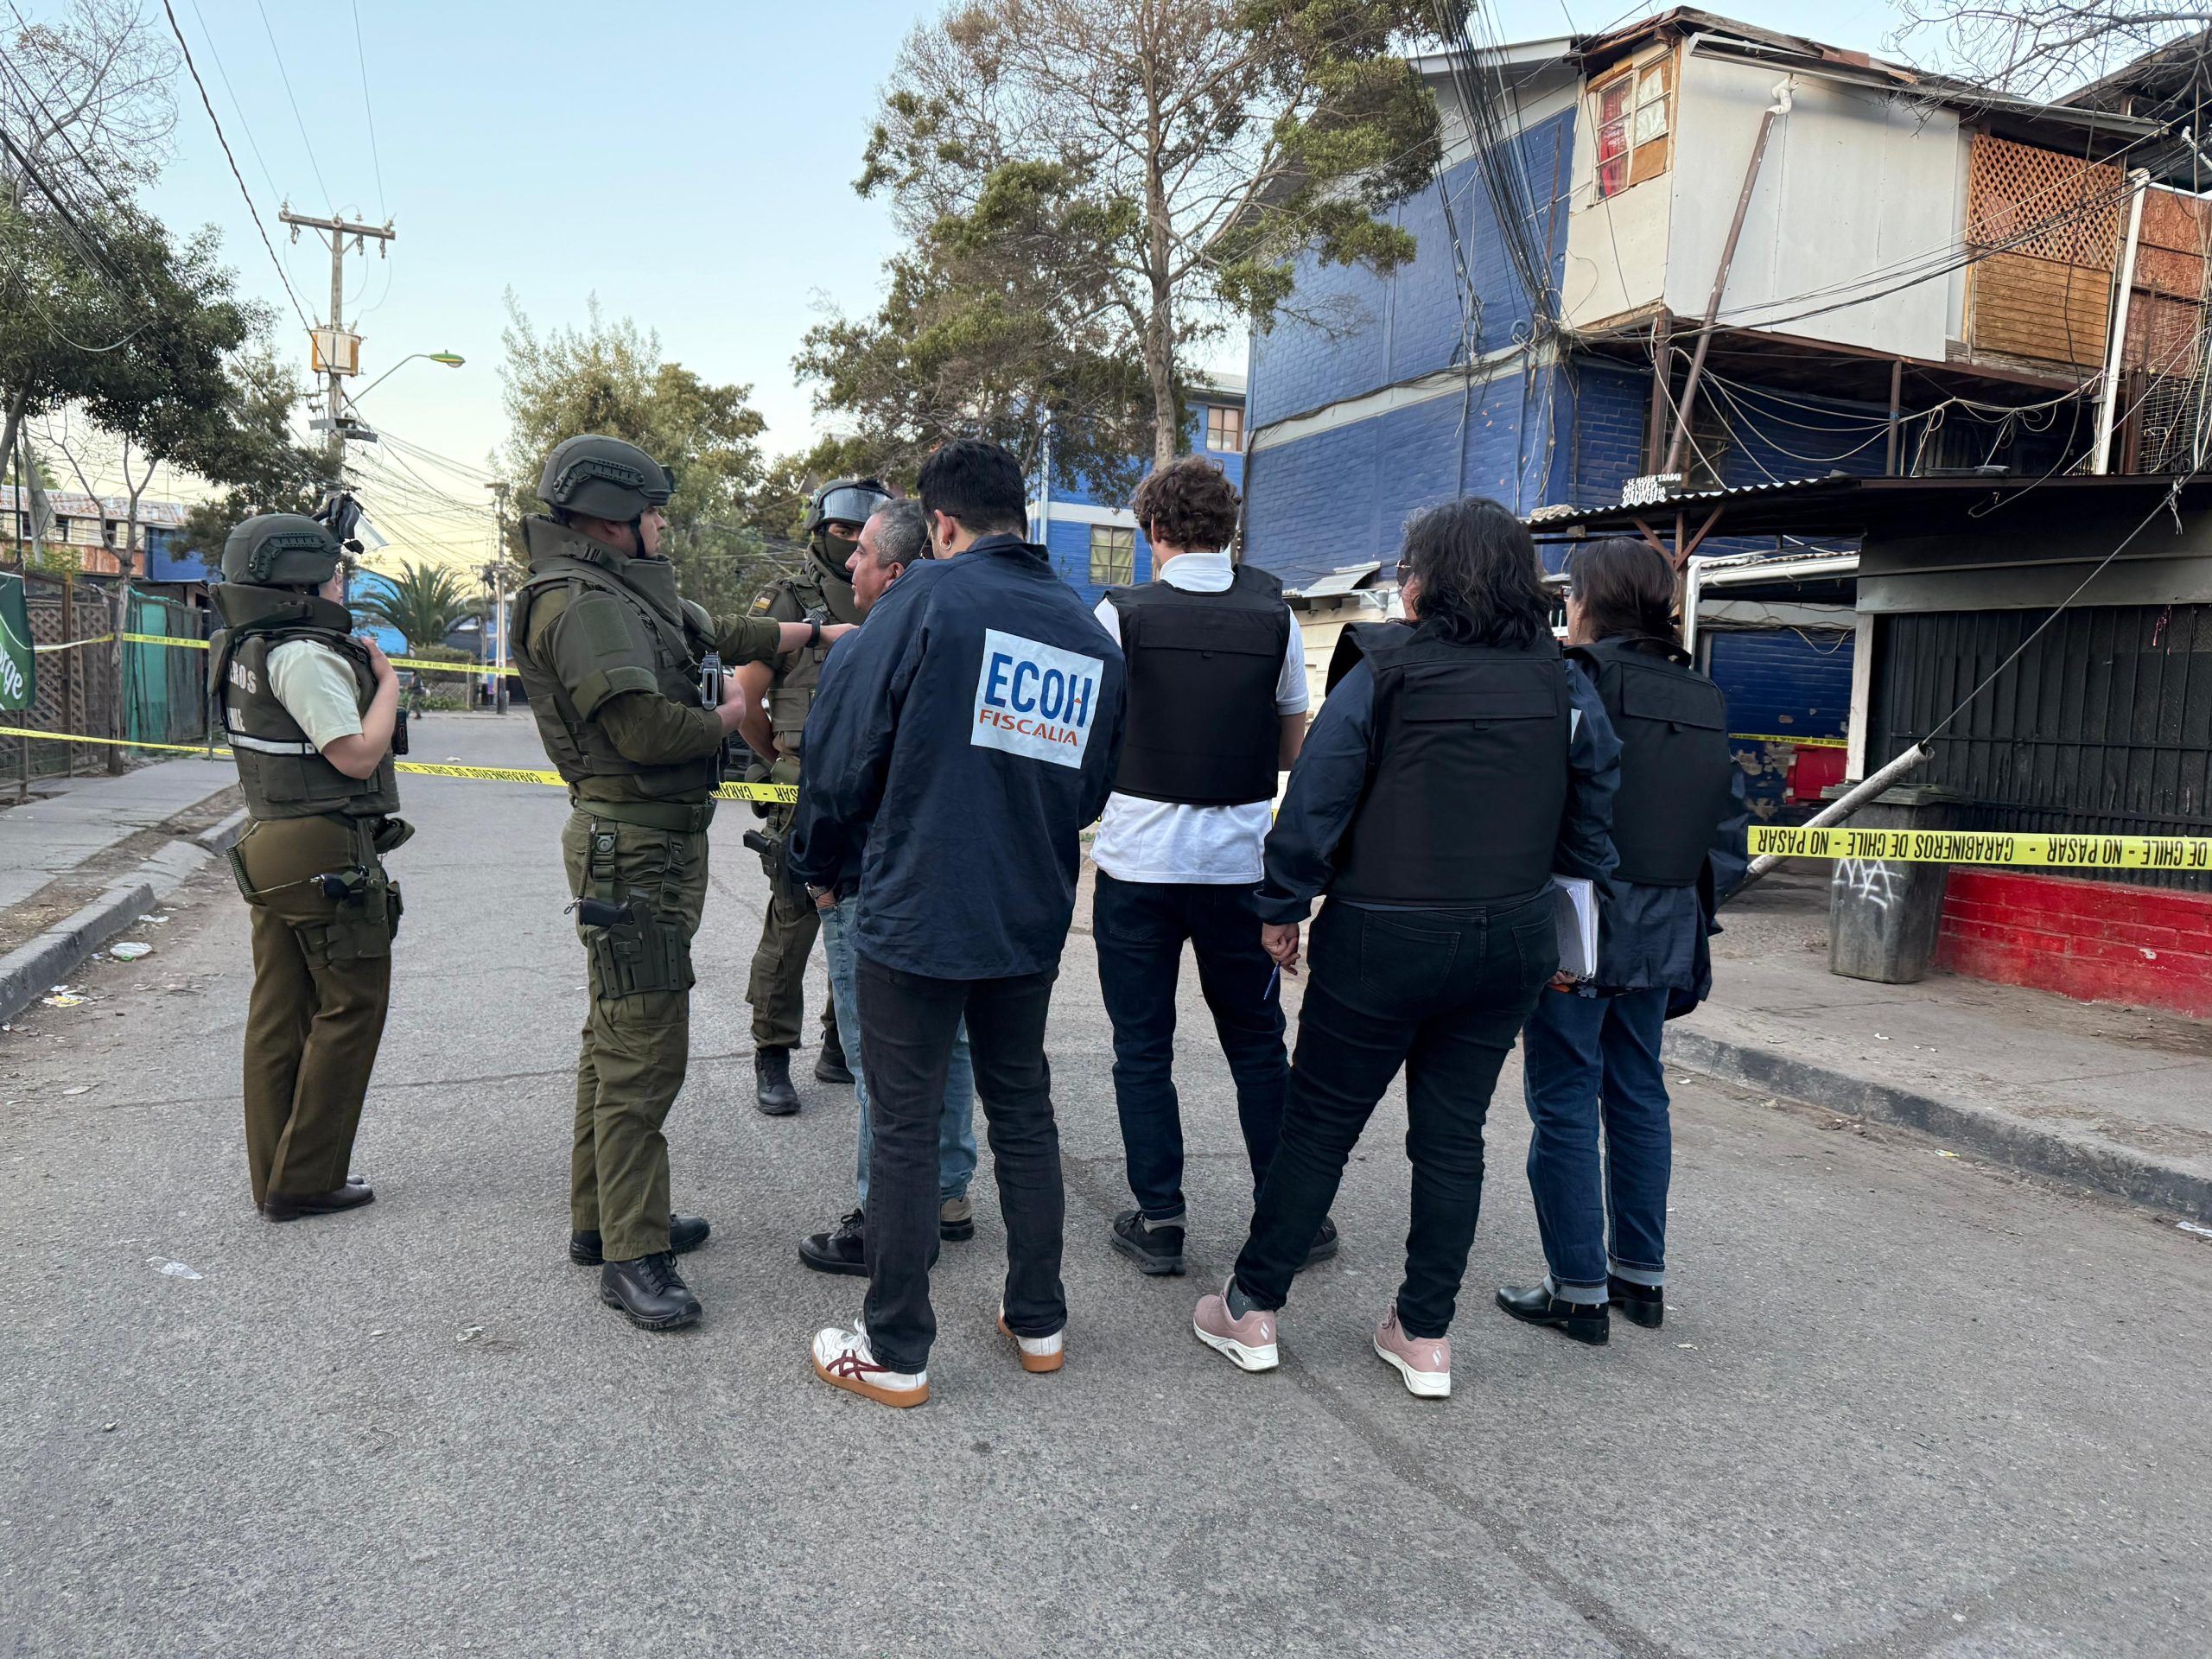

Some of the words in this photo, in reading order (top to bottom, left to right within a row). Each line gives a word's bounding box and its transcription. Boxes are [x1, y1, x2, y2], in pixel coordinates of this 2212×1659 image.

[230, 660, 257, 695] ROS
[984, 652, 1093, 728] ECOH
[979, 709, 1078, 747] FISCALIA
[712, 784, 753, 800] CARA
[774, 786, 798, 803] SAR
[1758, 829, 1806, 854] PASAR
[1810, 830, 1830, 855] NO
[1846, 831, 1886, 857] CHILE
[1889, 833, 1909, 859] DE
[1914, 834, 2014, 861] CARABINEROS
[2047, 836, 2098, 864] PASAR
[2102, 838, 2123, 865] NO
[2140, 839, 2183, 866] CHILE
[2187, 841, 2208, 868] DE
